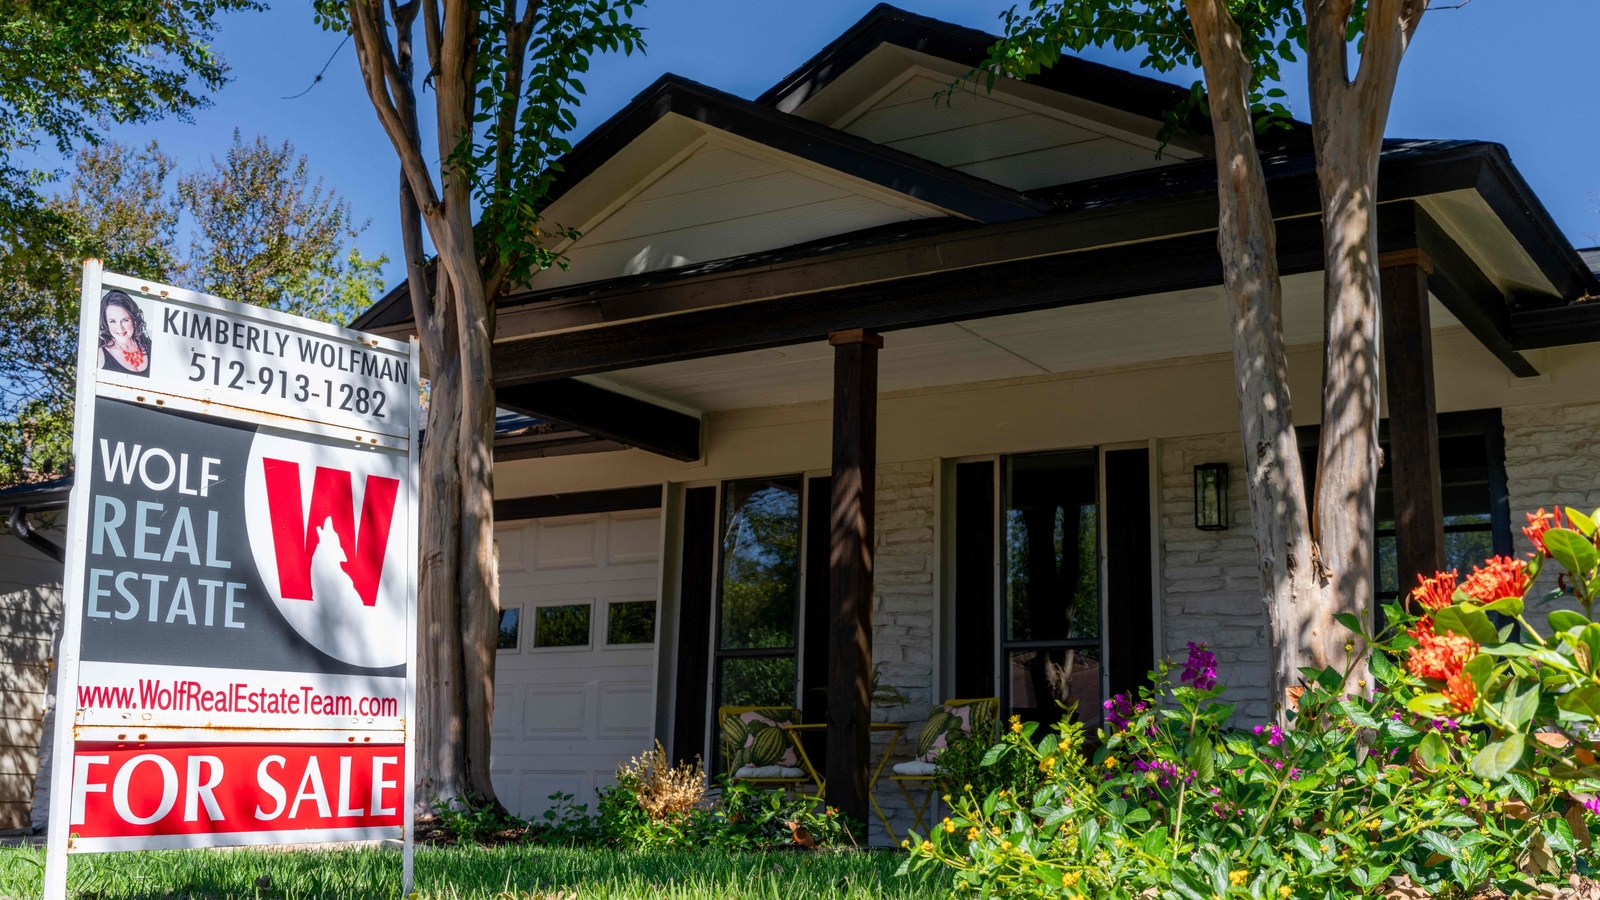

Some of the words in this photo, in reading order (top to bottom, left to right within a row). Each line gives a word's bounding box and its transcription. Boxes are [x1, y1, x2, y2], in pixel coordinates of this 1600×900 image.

[163, 307, 290, 358] KIMBERLY
[297, 337, 408, 385] WOLFMAN
[188, 352, 386, 418] 512-913-1282
[100, 438, 221, 497] WOLF
[91, 494, 232, 569] REAL
[262, 457, 400, 607] W
[87, 568, 247, 629] ESTATE
[77, 678, 398, 717] www.WolfRealEstateTeam.com
[70, 753, 226, 826] FOR
[254, 754, 398, 822] SALE
